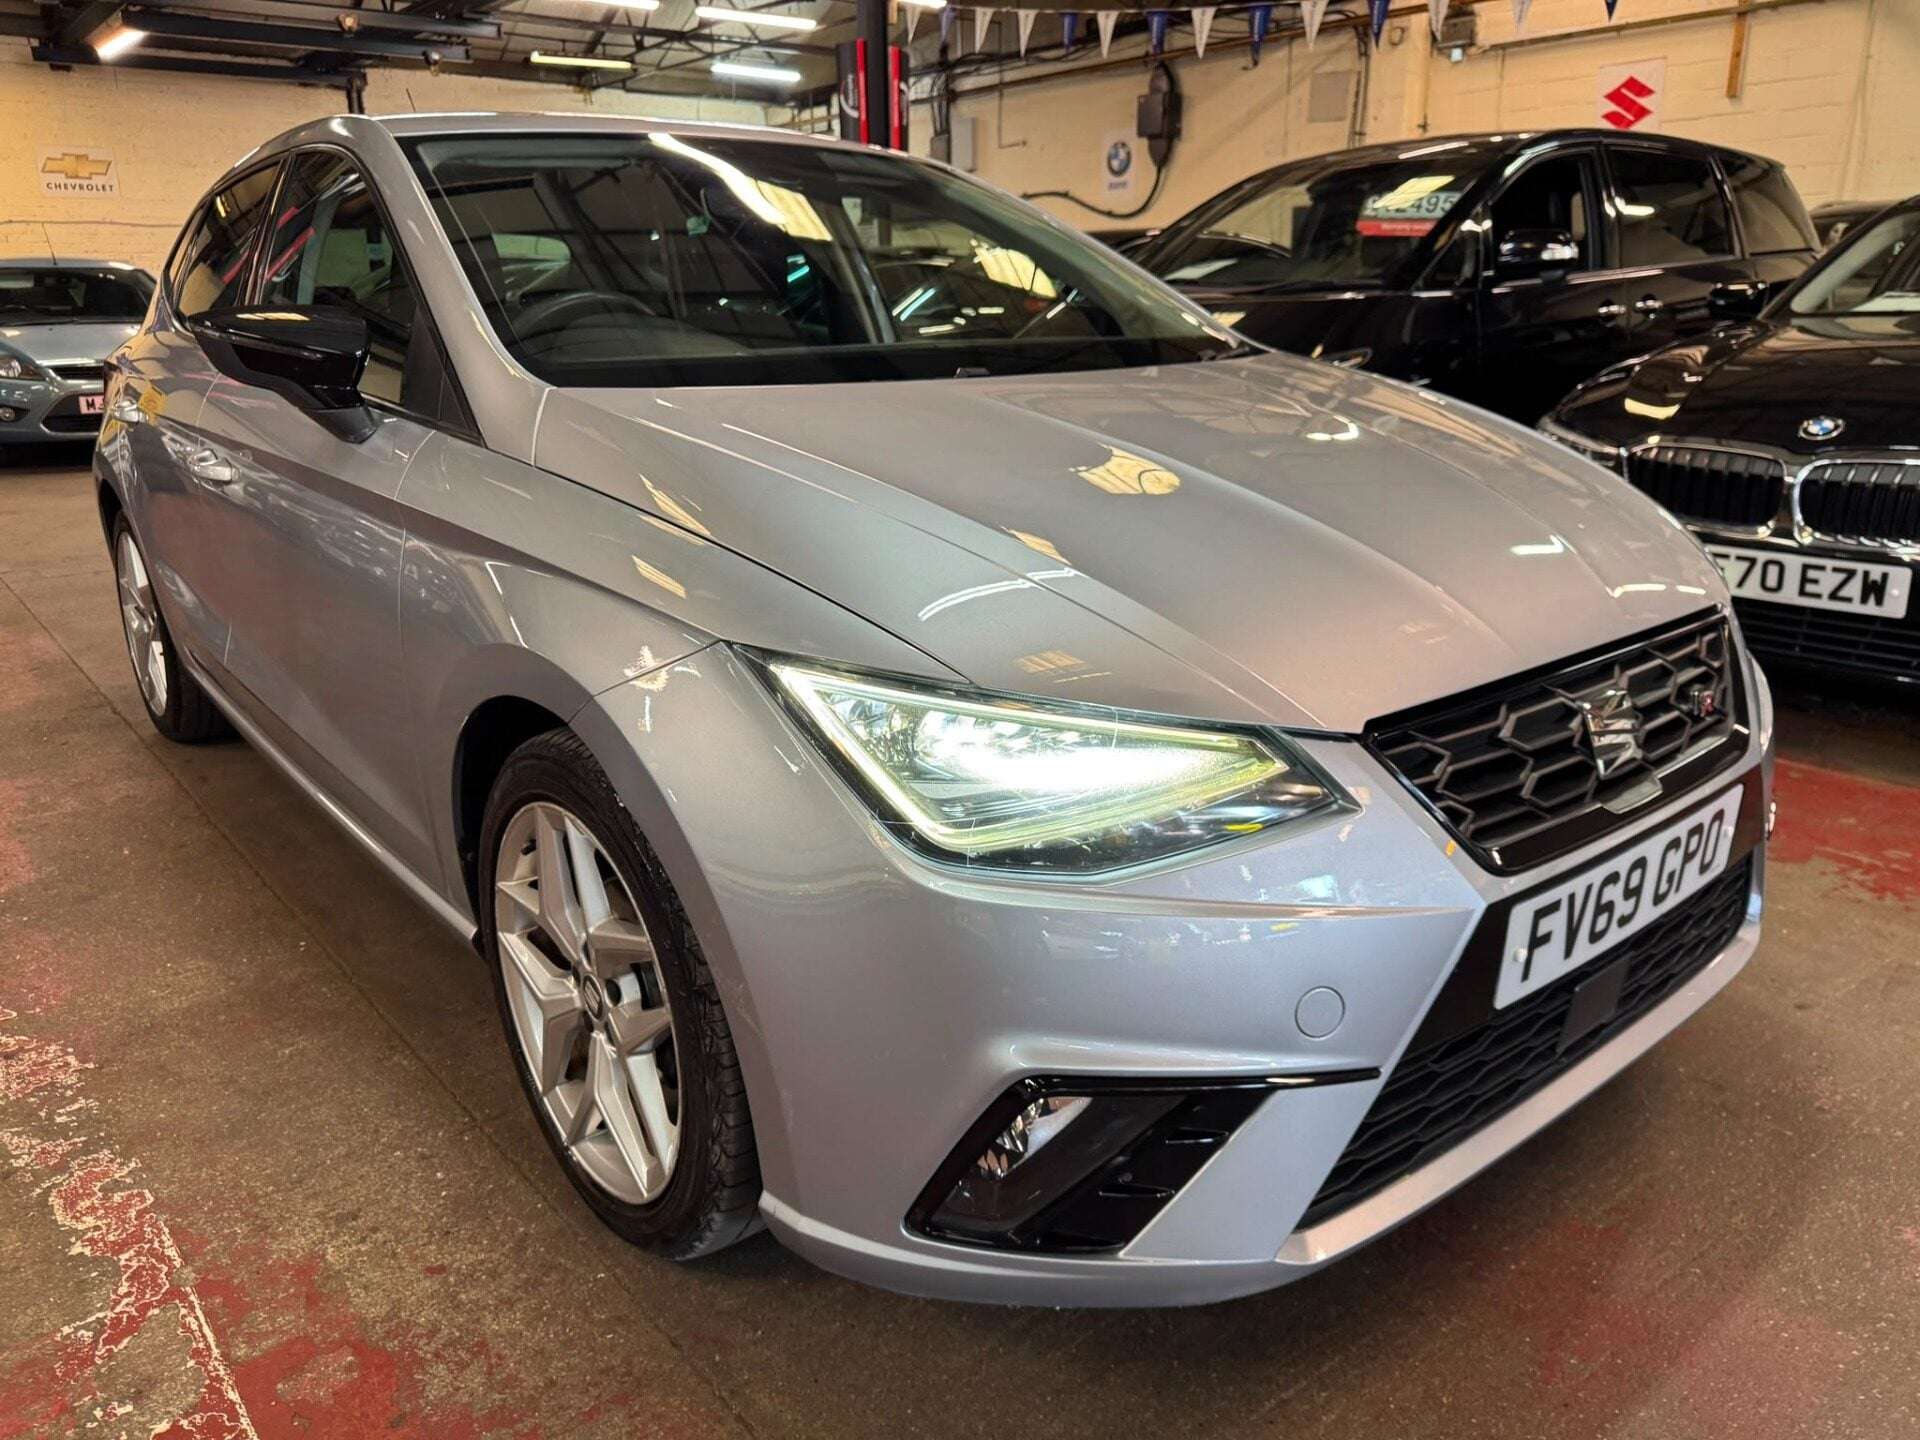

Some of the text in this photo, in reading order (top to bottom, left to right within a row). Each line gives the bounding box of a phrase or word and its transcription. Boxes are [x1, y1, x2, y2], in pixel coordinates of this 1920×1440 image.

[46, 182, 114, 192] CHEVROLET
[1798, 563, 1889, 606] EZW
[1520, 808, 1725, 982] FV69 GPO
